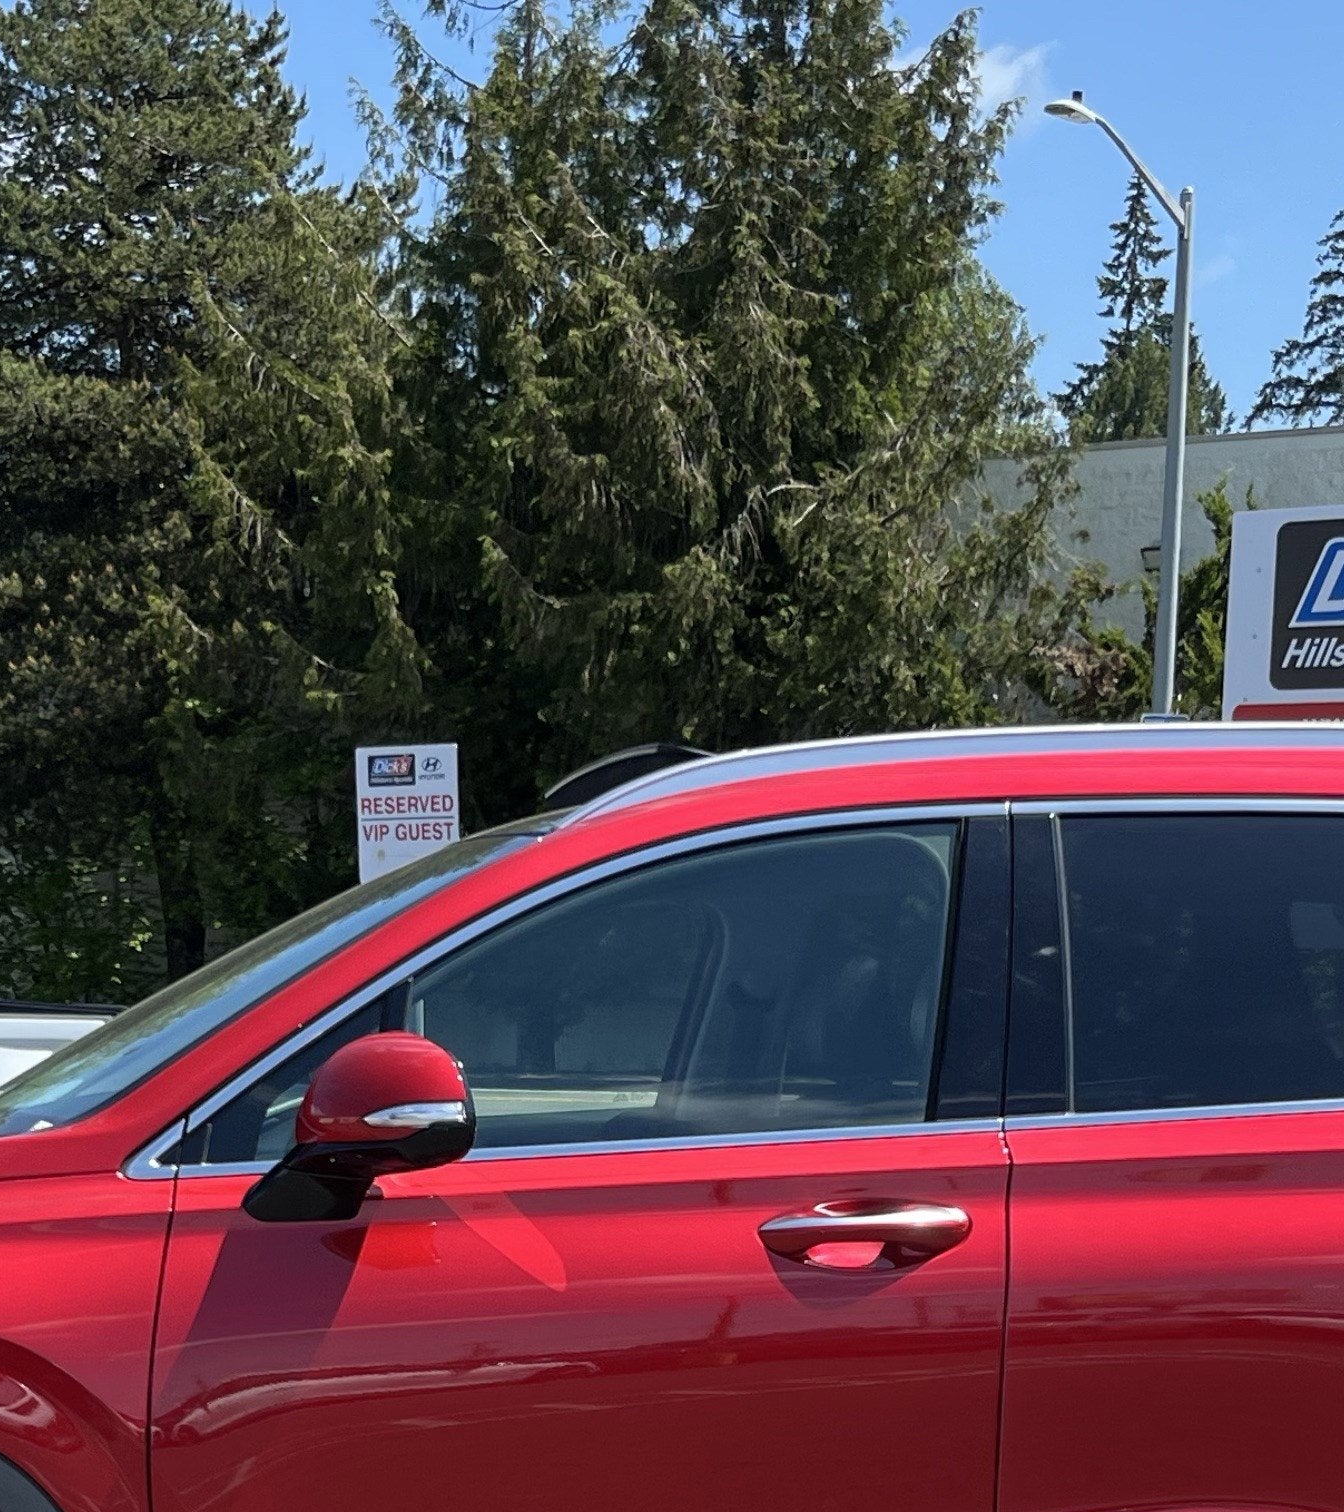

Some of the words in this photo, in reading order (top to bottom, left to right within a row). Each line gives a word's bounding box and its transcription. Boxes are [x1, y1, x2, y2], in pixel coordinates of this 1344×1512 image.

[361, 795, 454, 815] RESERVED
[363, 823, 389, 842] VIP
[395, 822, 454, 841] GUEST
